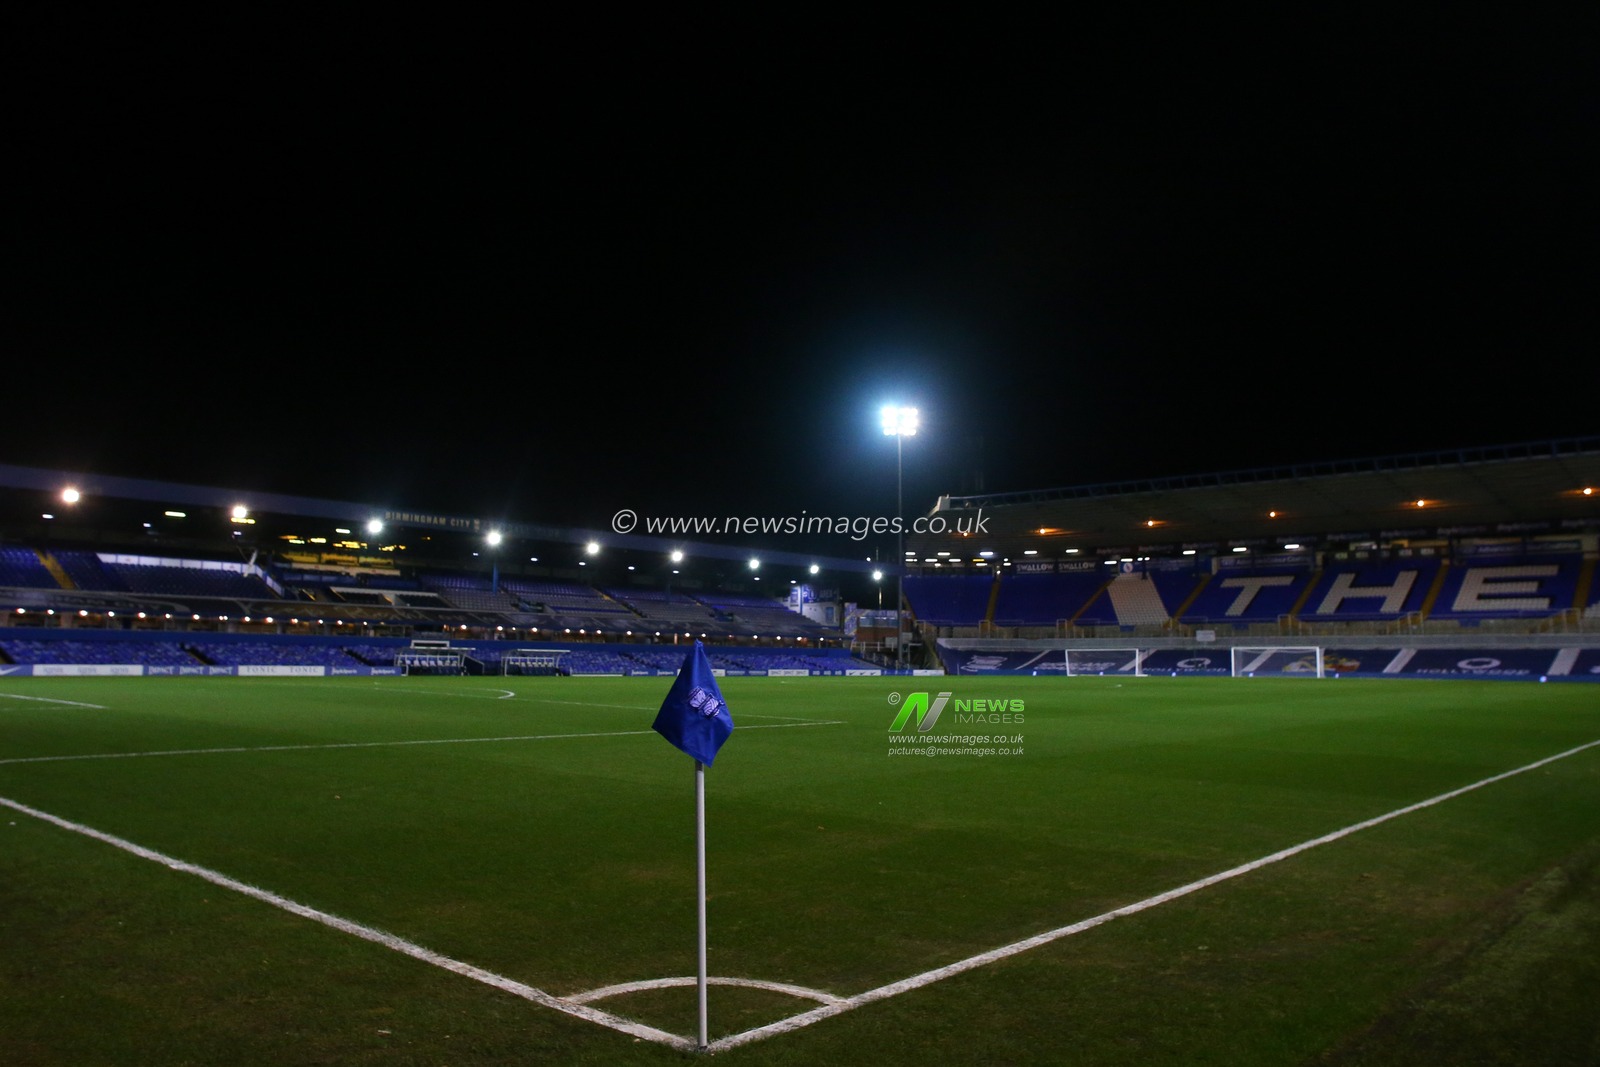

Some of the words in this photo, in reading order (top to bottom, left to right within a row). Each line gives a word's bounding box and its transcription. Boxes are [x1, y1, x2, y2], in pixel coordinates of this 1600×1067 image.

[384, 511, 447, 526] BIRMINGHAM
[450, 517, 471, 528] CITY
[1016, 563, 1054, 573] SWALLOW
[1058, 561, 1096, 571] SWALLOW
[1219, 565, 1559, 616] THE
